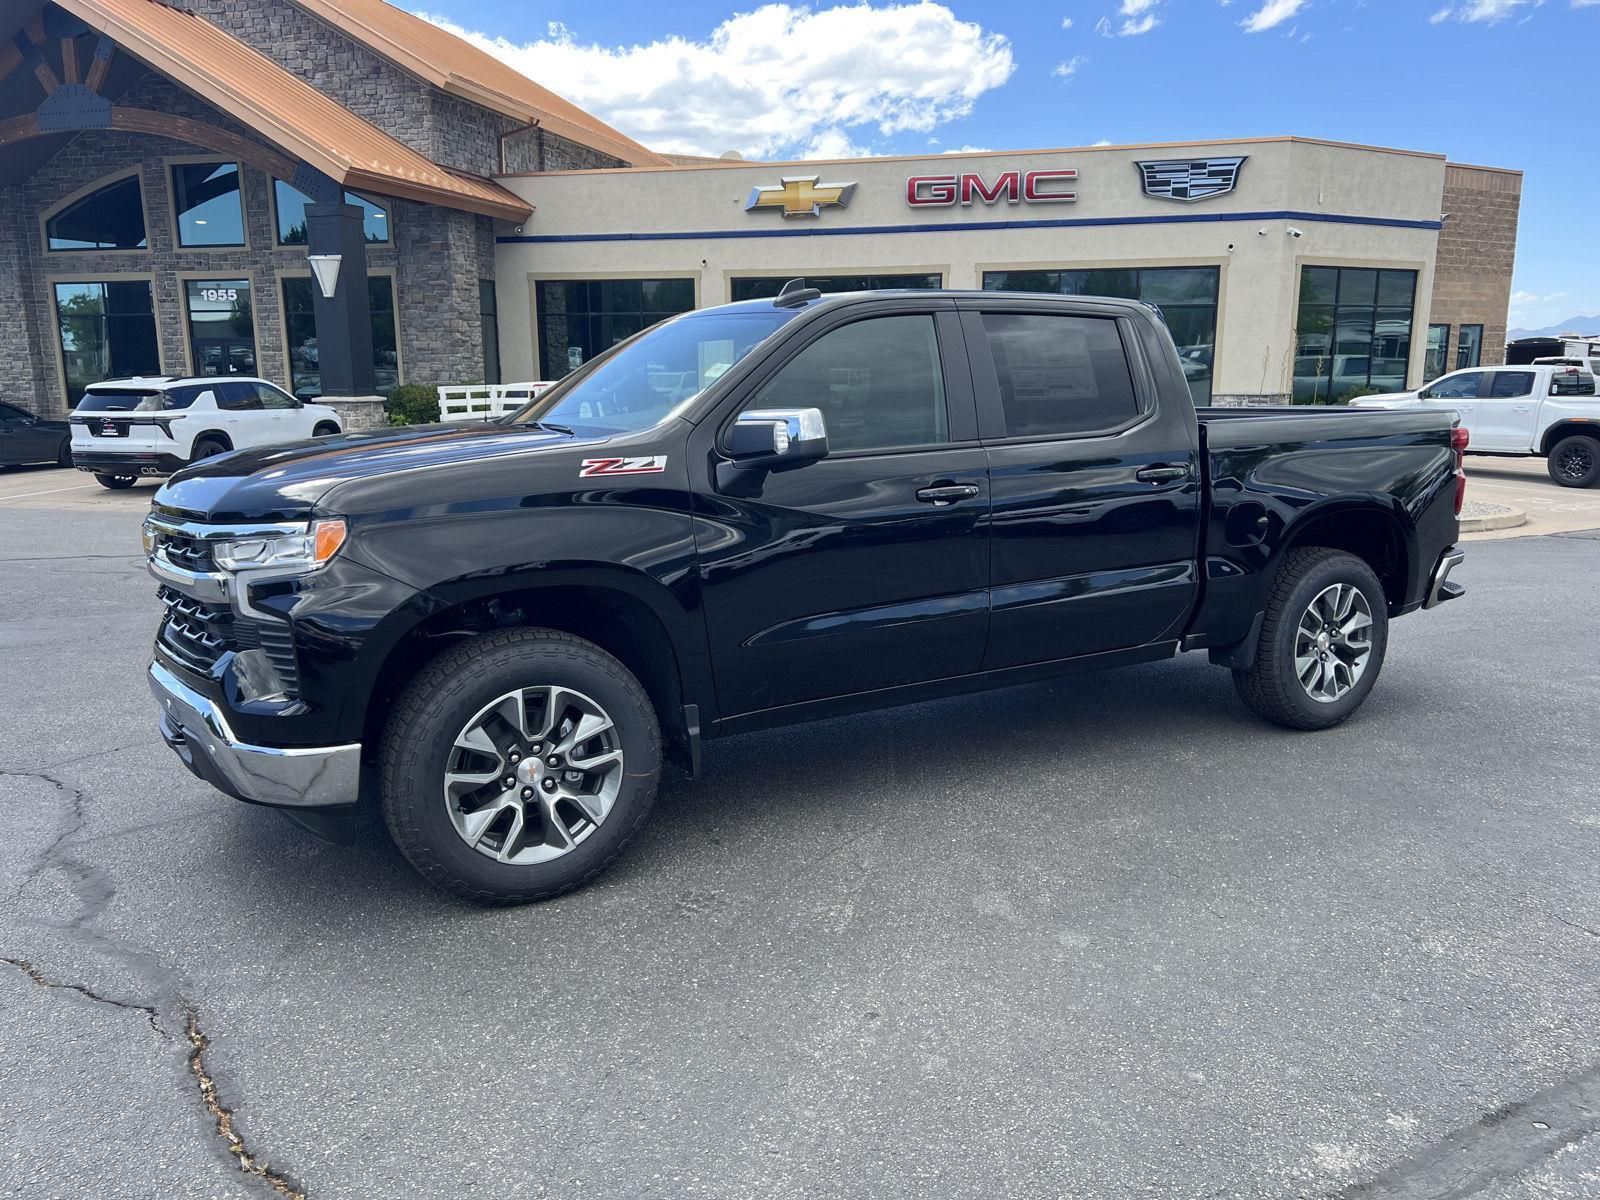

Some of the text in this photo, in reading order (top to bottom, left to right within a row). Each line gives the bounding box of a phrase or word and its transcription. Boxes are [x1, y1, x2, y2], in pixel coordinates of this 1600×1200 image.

[906, 168, 1078, 207] GMC
[200, 289, 238, 301] 1955
[578, 455, 668, 478] Z71
